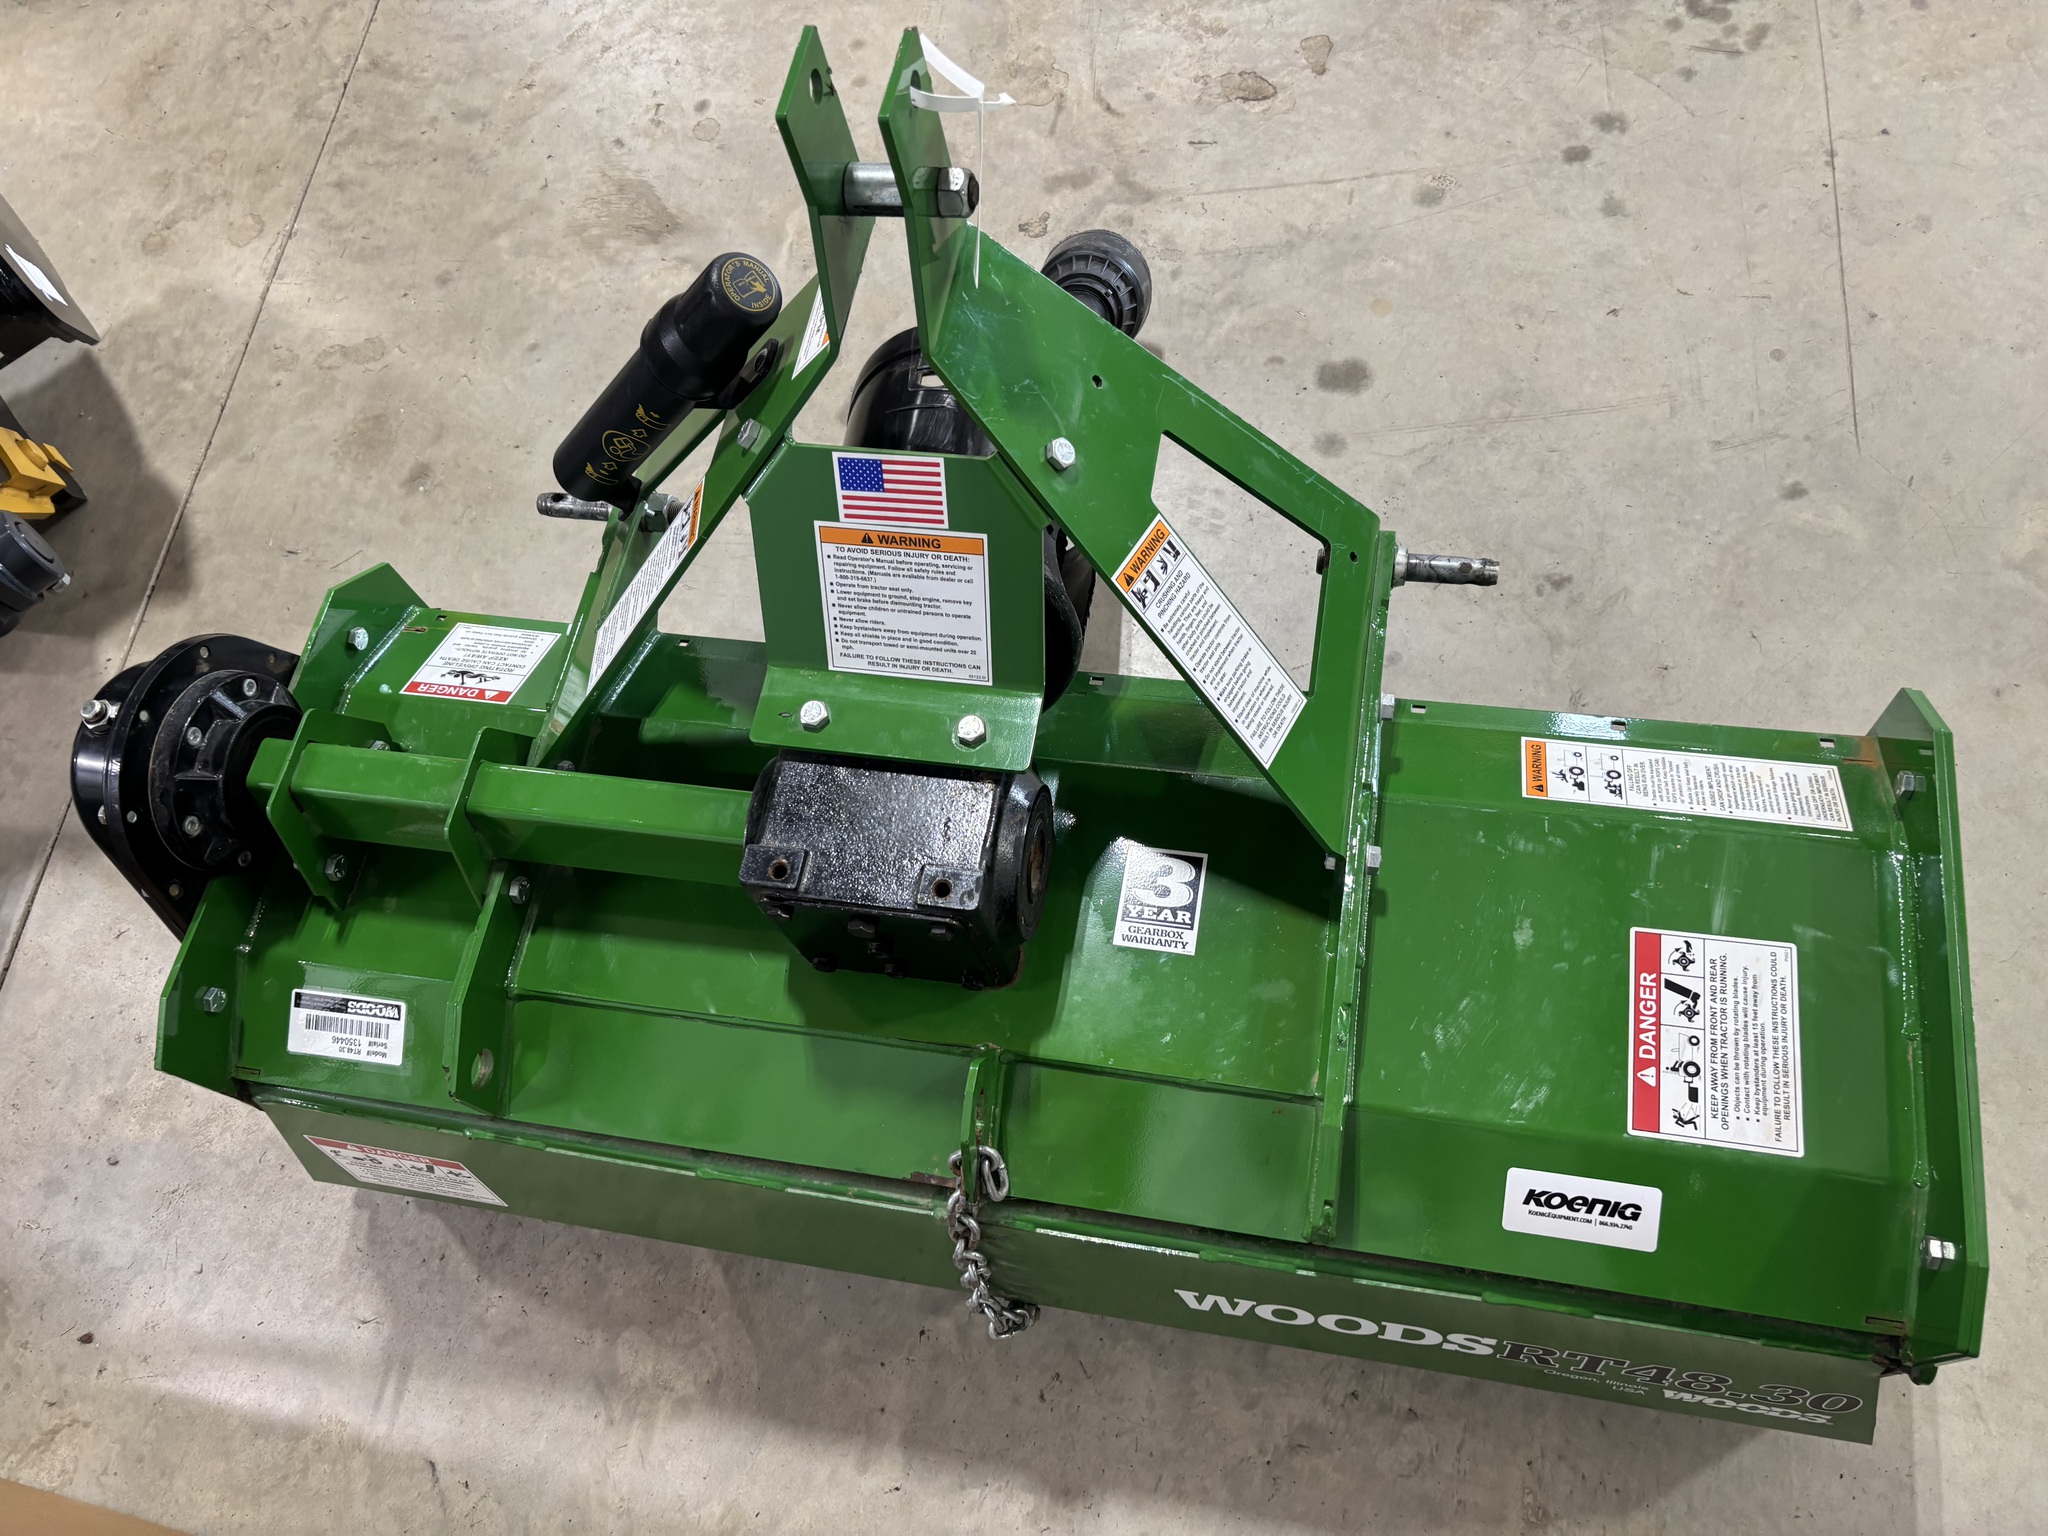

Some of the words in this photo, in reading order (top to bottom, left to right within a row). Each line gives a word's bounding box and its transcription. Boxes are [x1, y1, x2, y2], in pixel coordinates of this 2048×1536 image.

[724, 260, 740, 300] OPERATOR'S
[743, 260, 769, 282] MANUAL
[752, 294, 771, 308] INSIDE
[877, 534, 941, 549] WARNING
[1129, 528, 1165, 574] WARNING
[870, 548, 902, 557] SERIOUS
[903, 551, 929, 559] INJURY
[943, 554, 970, 562] DEATH:
[913, 561, 940, 569] operating,
[941, 563, 966, 571] servicing
[1155, 580, 1176, 608] CRUSHING
[1173, 569, 1183, 583] AND
[1157, 592, 1177, 619] PINCHING
[1174, 572, 1191, 595] HAZARD
[938, 632, 956, 640] during
[867, 660, 890, 668] RESULT
[901, 657, 921, 665] THESE
[922, 660, 966, 669] INSTRUCTIONS
[417, 683, 479, 697] DANGER
[1531, 744, 1542, 782] WARNING
[1131, 853, 1196, 907] 3
[1126, 904, 1192, 924] YEAR
[1121, 934, 1189, 950] WARRANTY
[1128, 925, 1184, 940] GEARBOX
[1709, 958, 1717, 982] REAR
[1719, 953, 1727, 995] RUNNING.
[1741, 965, 1749, 985] injury.
[1709, 984, 1717, 1004] AND
[1719, 996, 1727, 1005] IS
[1779, 975, 1787, 1002] DEATH.
[347, 1000, 399, 1018] WOODS
[1638, 972, 1656, 1059] DANGER
[1732, 1000, 1740, 1026] rotating
[1770, 978, 1778, 1033] INSTRUCTIONS
[1780, 1003, 1787, 1014] OR
[1709, 1005, 1718, 1036] FRONT
[1719, 1007, 1728, 1050] TRACTOR
[1732, 1027, 1740, 1036] by
[1751, 1022, 1758, 1030] 15
[1780, 1015, 1788, 1043] INJURY
[331, 1035, 361, 1047] 1350446
[1759, 1021, 1767, 1055] operation.
[1771, 1035, 1779, 1059] THESE
[1710, 1038, 1718, 1064] FROM
[1742, 1043, 1750, 1070] rotating
[1752, 1049, 1759, 1057] at
[1781, 1044, 1789, 1079] SERIOUS
[1720, 1052, 1728, 1080] WHEN
[1733, 1062, 1740, 1071] be
[1759, 1056, 1767, 1078] during
[1772, 1061, 1781, 1095] FOLLOW
[1710, 1066, 1718, 1092] AWAY
[1782, 1080, 1790, 1088] IN
[1710, 1094, 1718, 1119] KEEP
[1720, 1082, 1729, 1130] OPENINGS
[1733, 1086, 1741, 1112] Objects
[1753, 1097, 1761, 1115] Keep
[1760, 1079, 1768, 1116] equipment
[1773, 1096, 1781, 1107] TO
[1782, 1089, 1790, 1120] RESULT
[1774, 1109, 1782, 1142] FAILURE
[363, 1147, 433, 1164] DANGER
[1173, 1288, 1498, 1355] WOODS
[1496, 1340, 1863, 1413] RT48.30
[1544, 1369, 1600, 1383] Oregon,
[1606, 1379, 1649, 1390] Illinois
[1612, 1385, 1645, 1395] USA
[1662, 1389, 1832, 1424] WOODS
